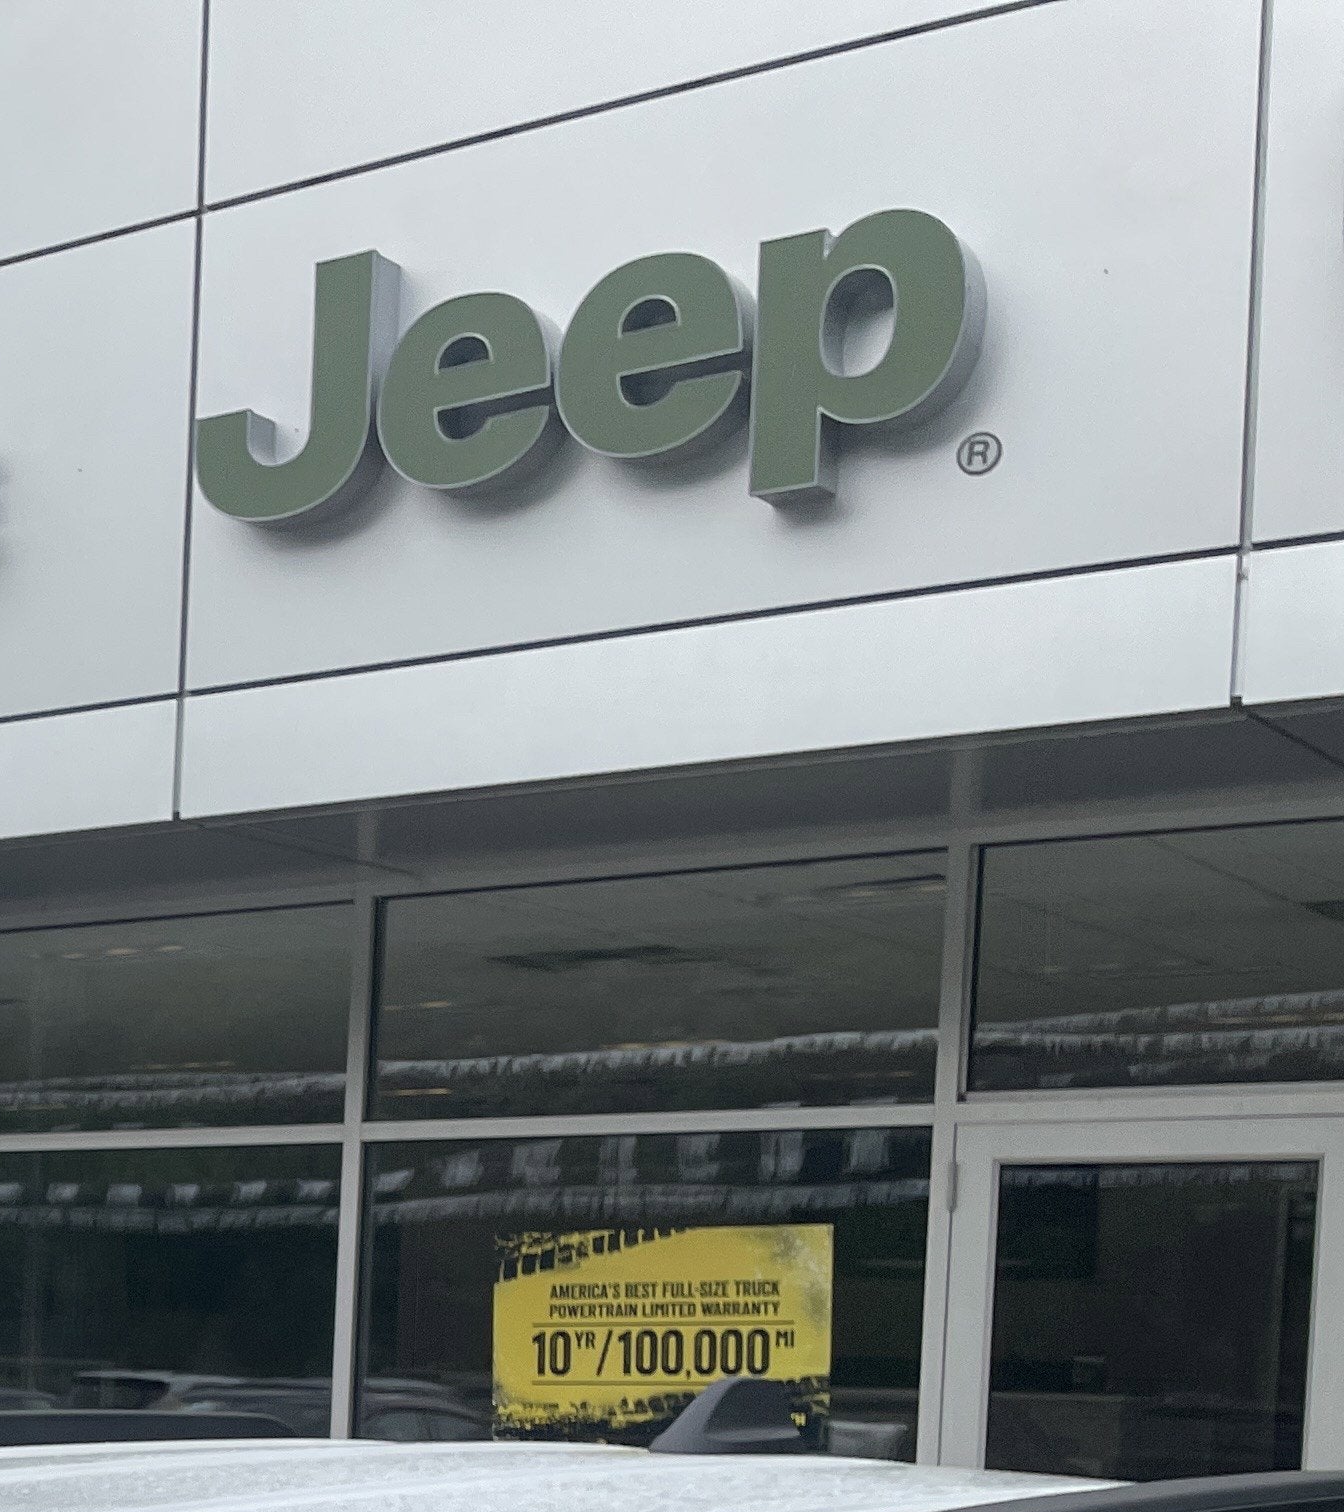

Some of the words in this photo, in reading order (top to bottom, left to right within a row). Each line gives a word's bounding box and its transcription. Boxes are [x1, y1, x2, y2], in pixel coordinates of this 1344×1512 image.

[194, 207, 977, 522] Jeep
[550, 1283, 621, 1301] AMERICA'S
[625, 1281, 659, 1300] BEST
[662, 1280, 730, 1300] FULL-SIZE
[734, 1279, 780, 1297] TRUCK
[549, 1304, 638, 1319] POWERTRAIN
[642, 1303, 697, 1318] LIMITED
[701, 1301, 780, 1317] WARRANTY
